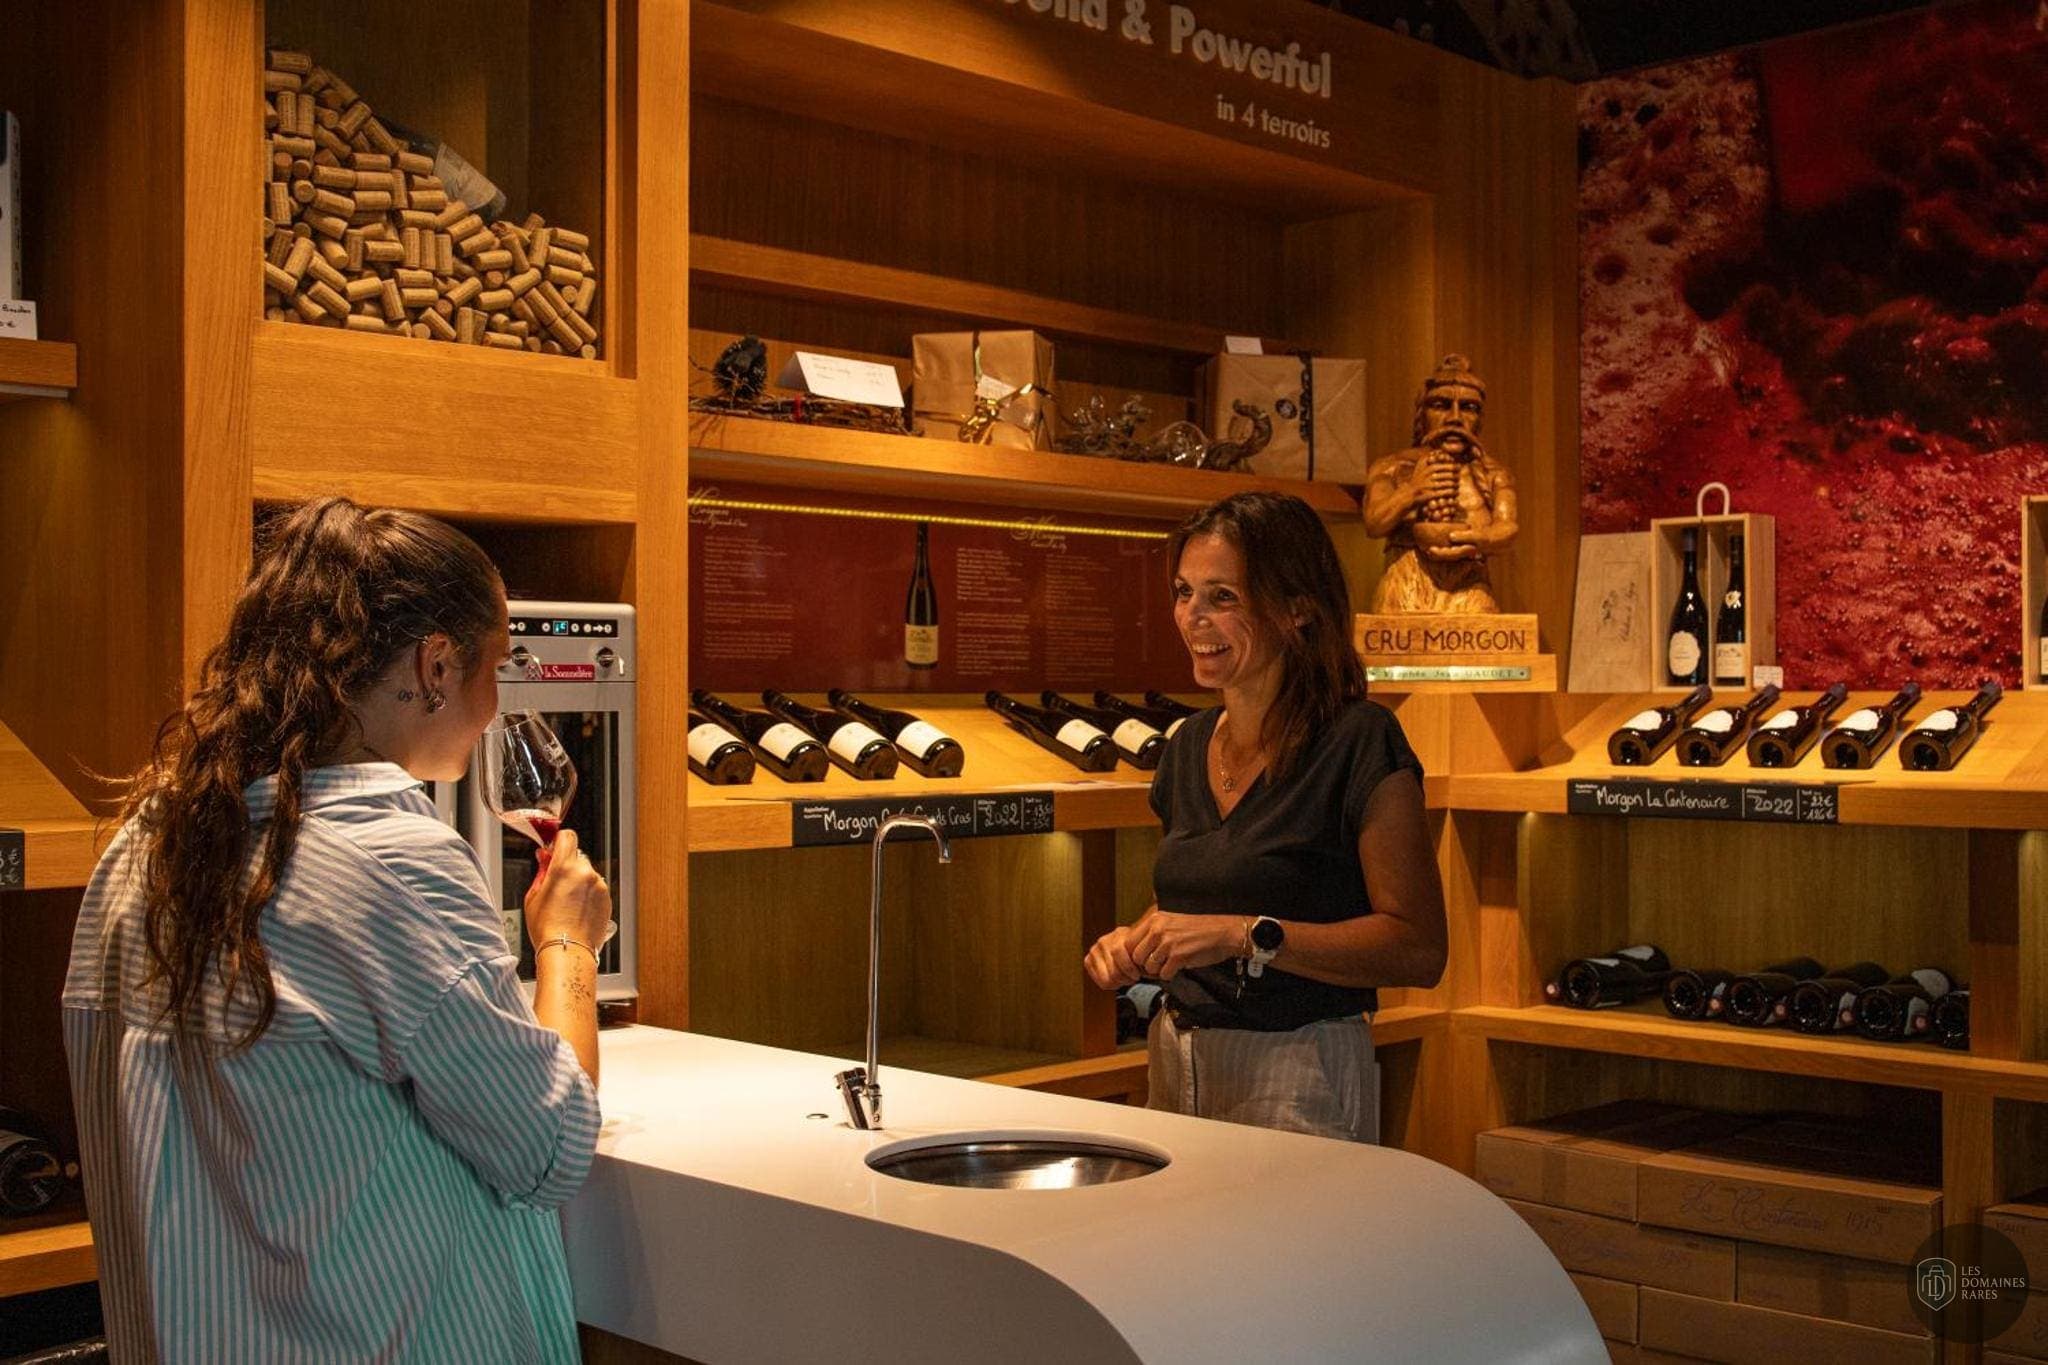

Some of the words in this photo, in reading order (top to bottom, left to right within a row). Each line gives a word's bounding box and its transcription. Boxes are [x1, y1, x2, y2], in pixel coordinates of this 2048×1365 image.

[1121, 0, 1153, 44] &
[1170, 4, 1331, 98] Powerful
[1216, 94, 1235, 122] in
[1241, 103, 1255, 127] 4
[1261, 110, 1331, 149] terroirs
[1364, 629, 1412, 651] CRU
[1423, 629, 1526, 651] MORGON
[1597, 785, 1644, 813] Morgon
[1647, 789, 1662, 807] La
[1665, 788, 1730, 809] Centenaire
[1754, 797, 1794, 816] 2022
[824, 810, 879, 839] Morgon
